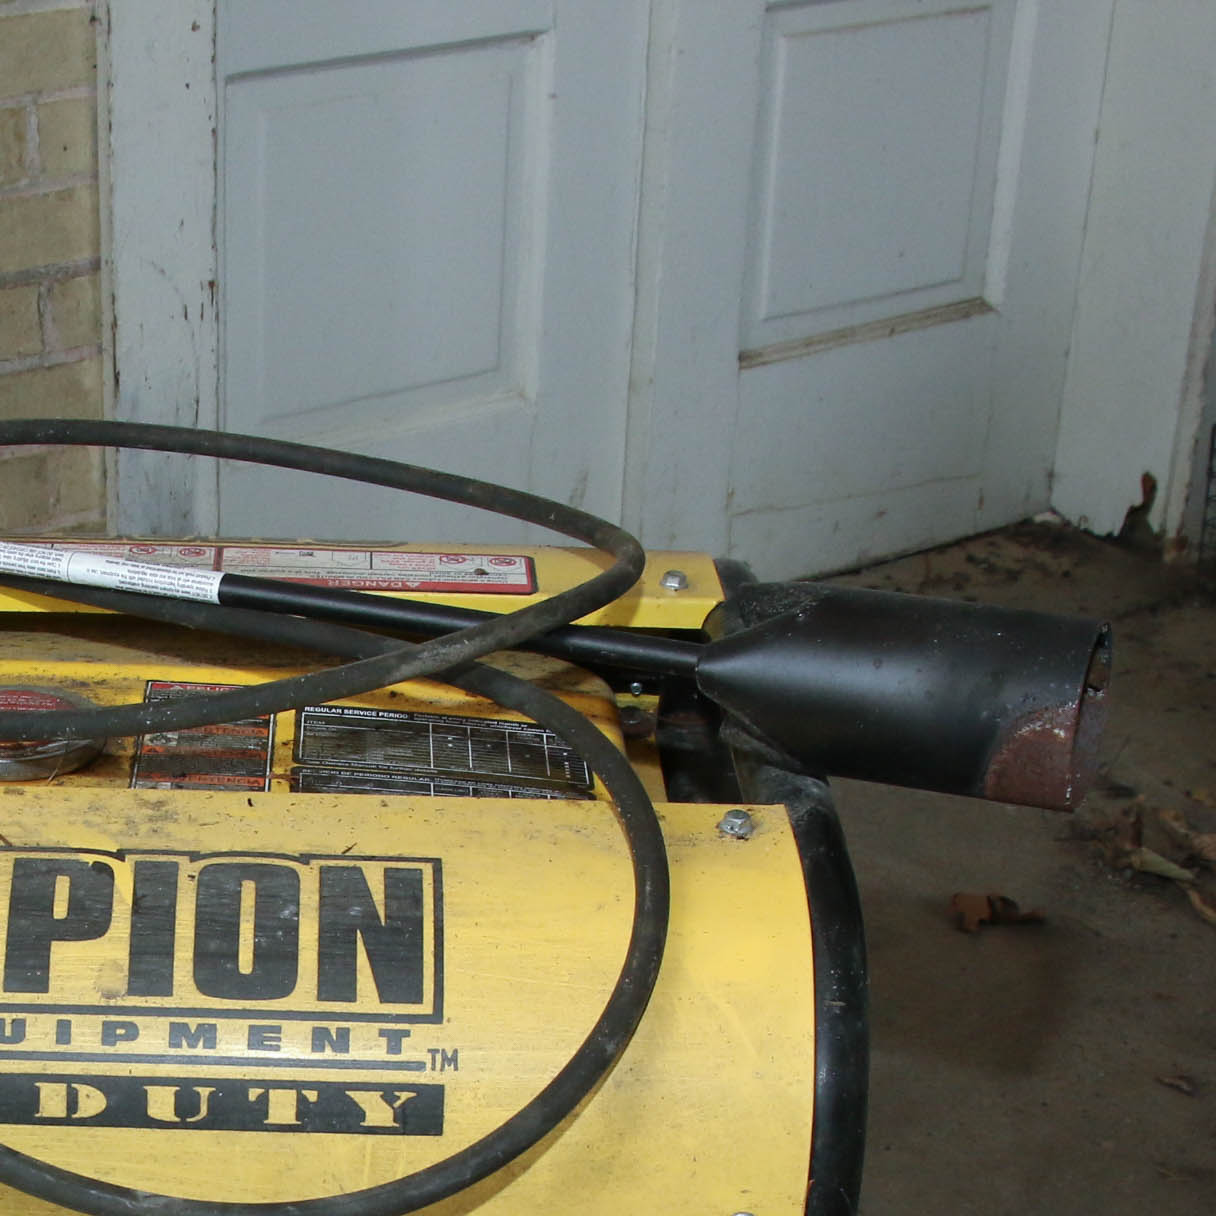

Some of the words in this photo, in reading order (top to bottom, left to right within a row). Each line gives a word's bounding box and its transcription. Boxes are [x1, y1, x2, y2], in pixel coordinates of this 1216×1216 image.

[329, 580, 403, 589] DANGER
[304, 706, 342, 714] REGULAR
[344, 708, 377, 717] SERVICE
[379, 711, 408, 719] PERIOD
[34, 1082, 418, 1128] DUTY
